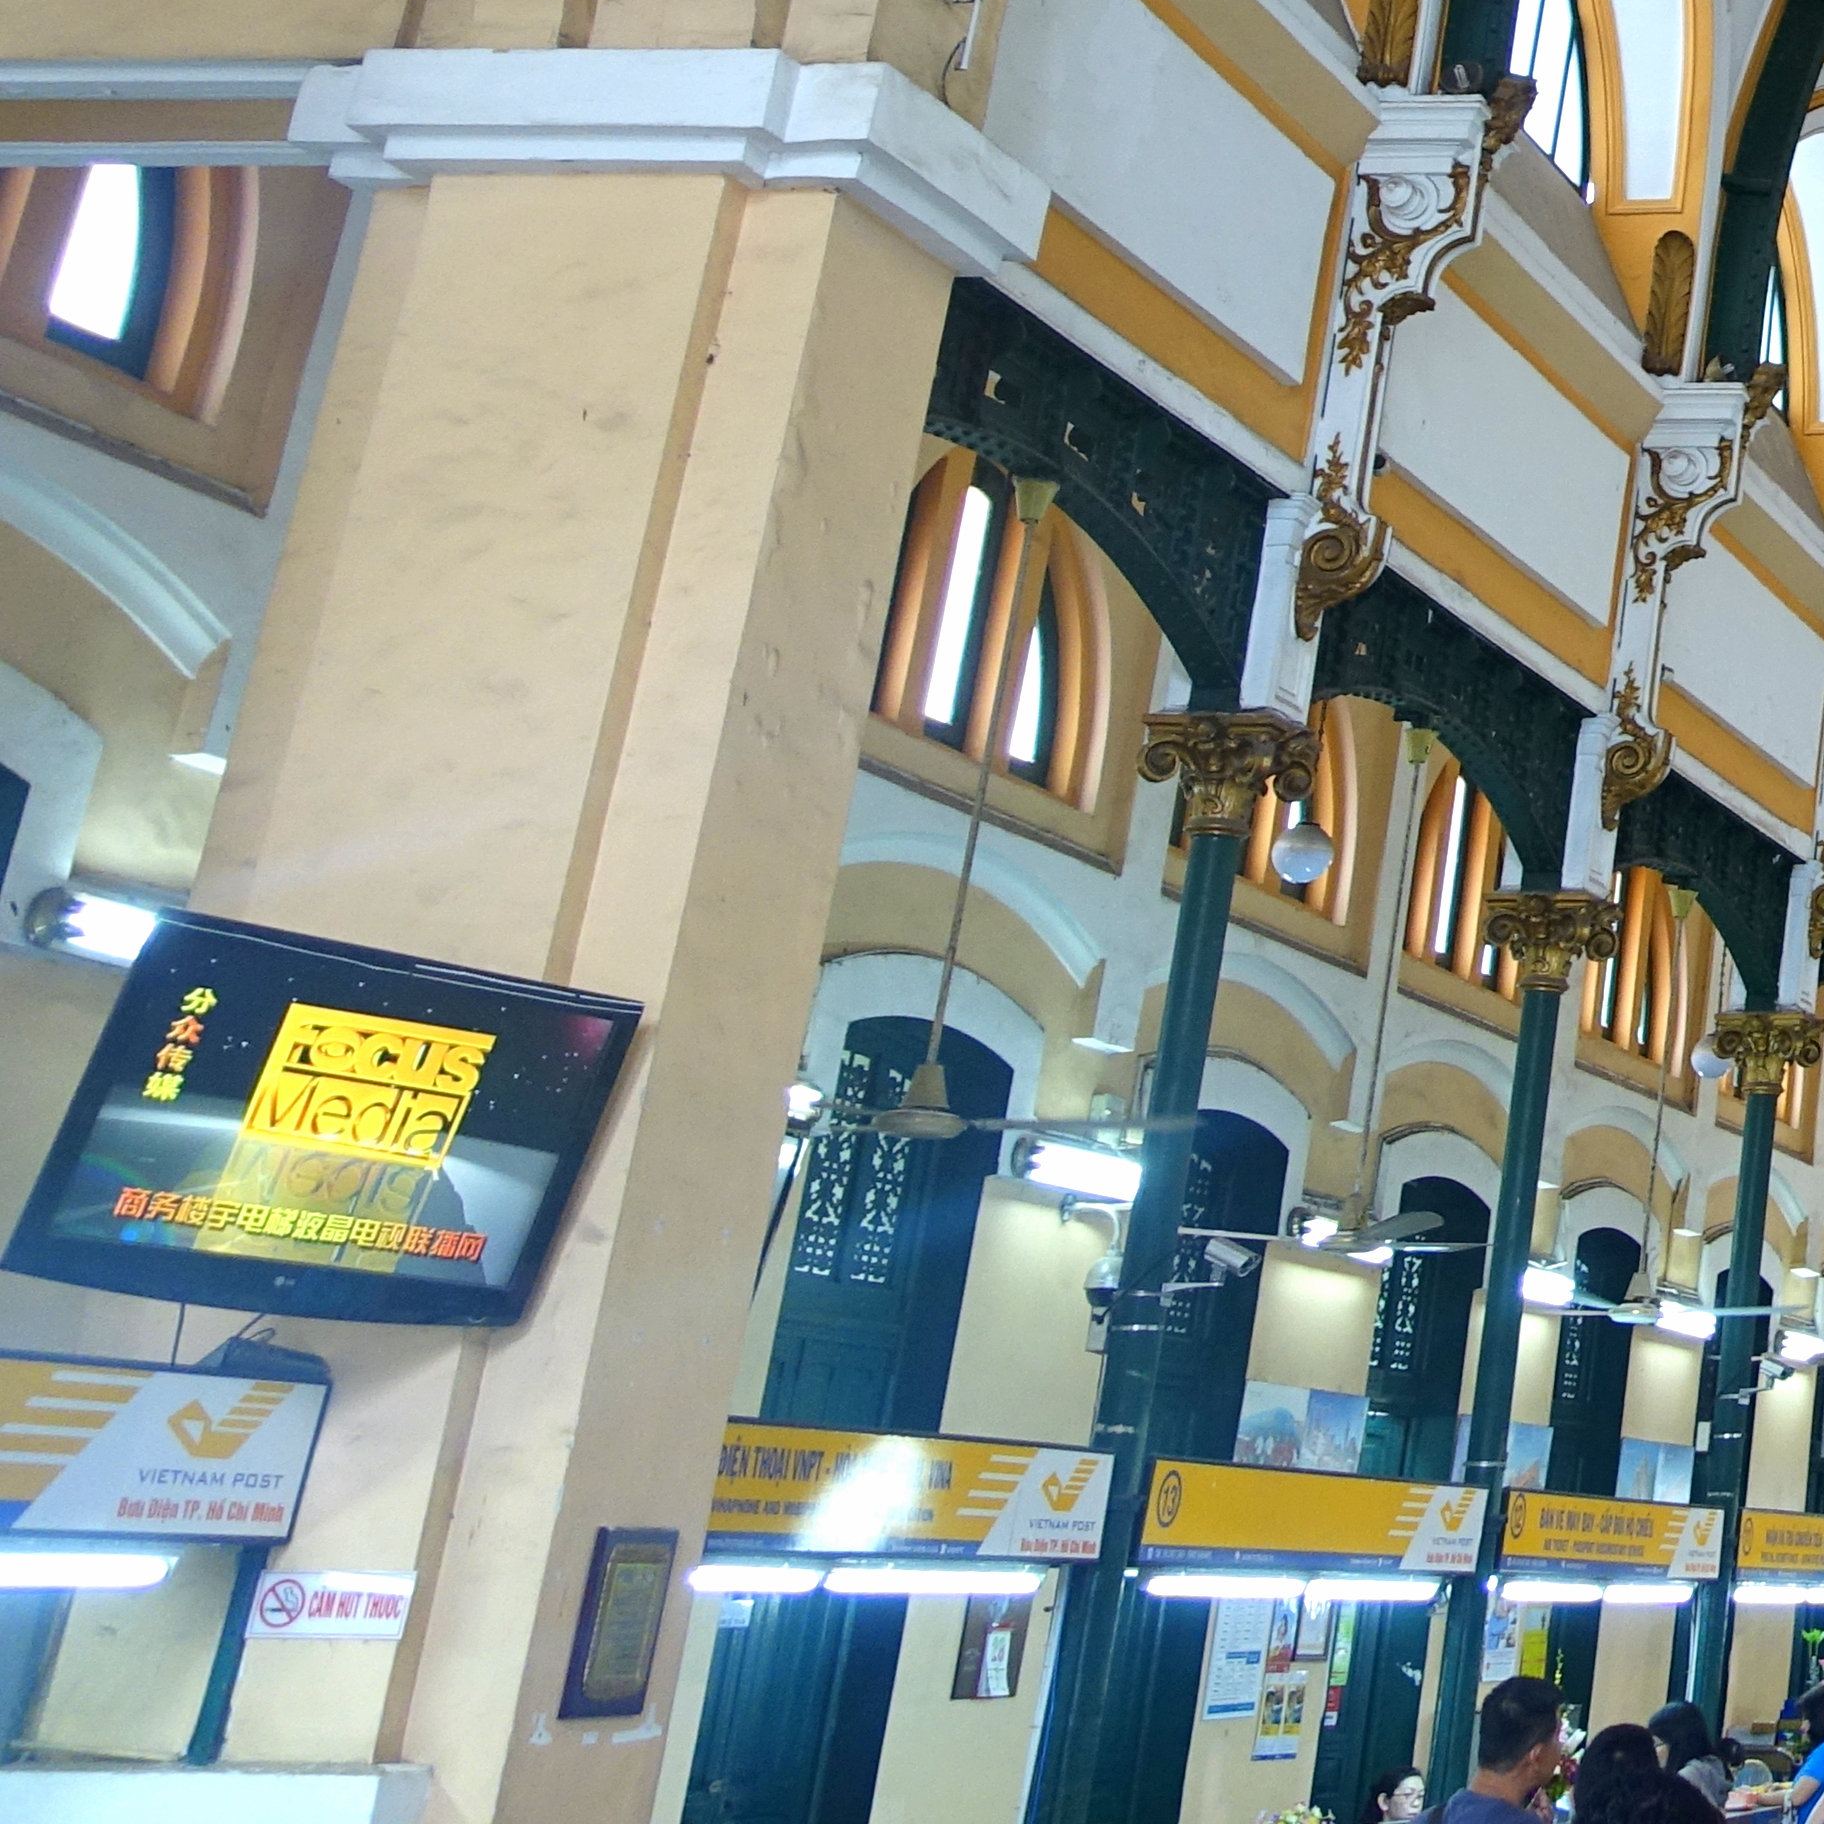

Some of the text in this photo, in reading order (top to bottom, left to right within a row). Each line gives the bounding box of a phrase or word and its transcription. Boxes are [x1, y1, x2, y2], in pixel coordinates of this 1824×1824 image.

[142, 987, 219, 1102] 分众传媒
[250, 1075, 452, 1155] Media
[113, 1186, 488, 1262] 商务楼宇电梯液晶电视联播网
[139, 1468, 284, 1490] VIETNAM POST
[718, 1435, 752, 1485] ĐIỆN
[752, 1445, 790, 1487] THOẠI
[792, 1449, 826, 1482] VNPT
[251, 1501, 285, 1523] Minh
[1161, 1484, 1179, 1517] 13
[1029, 1518, 1097, 1532] VIETNAM POST
